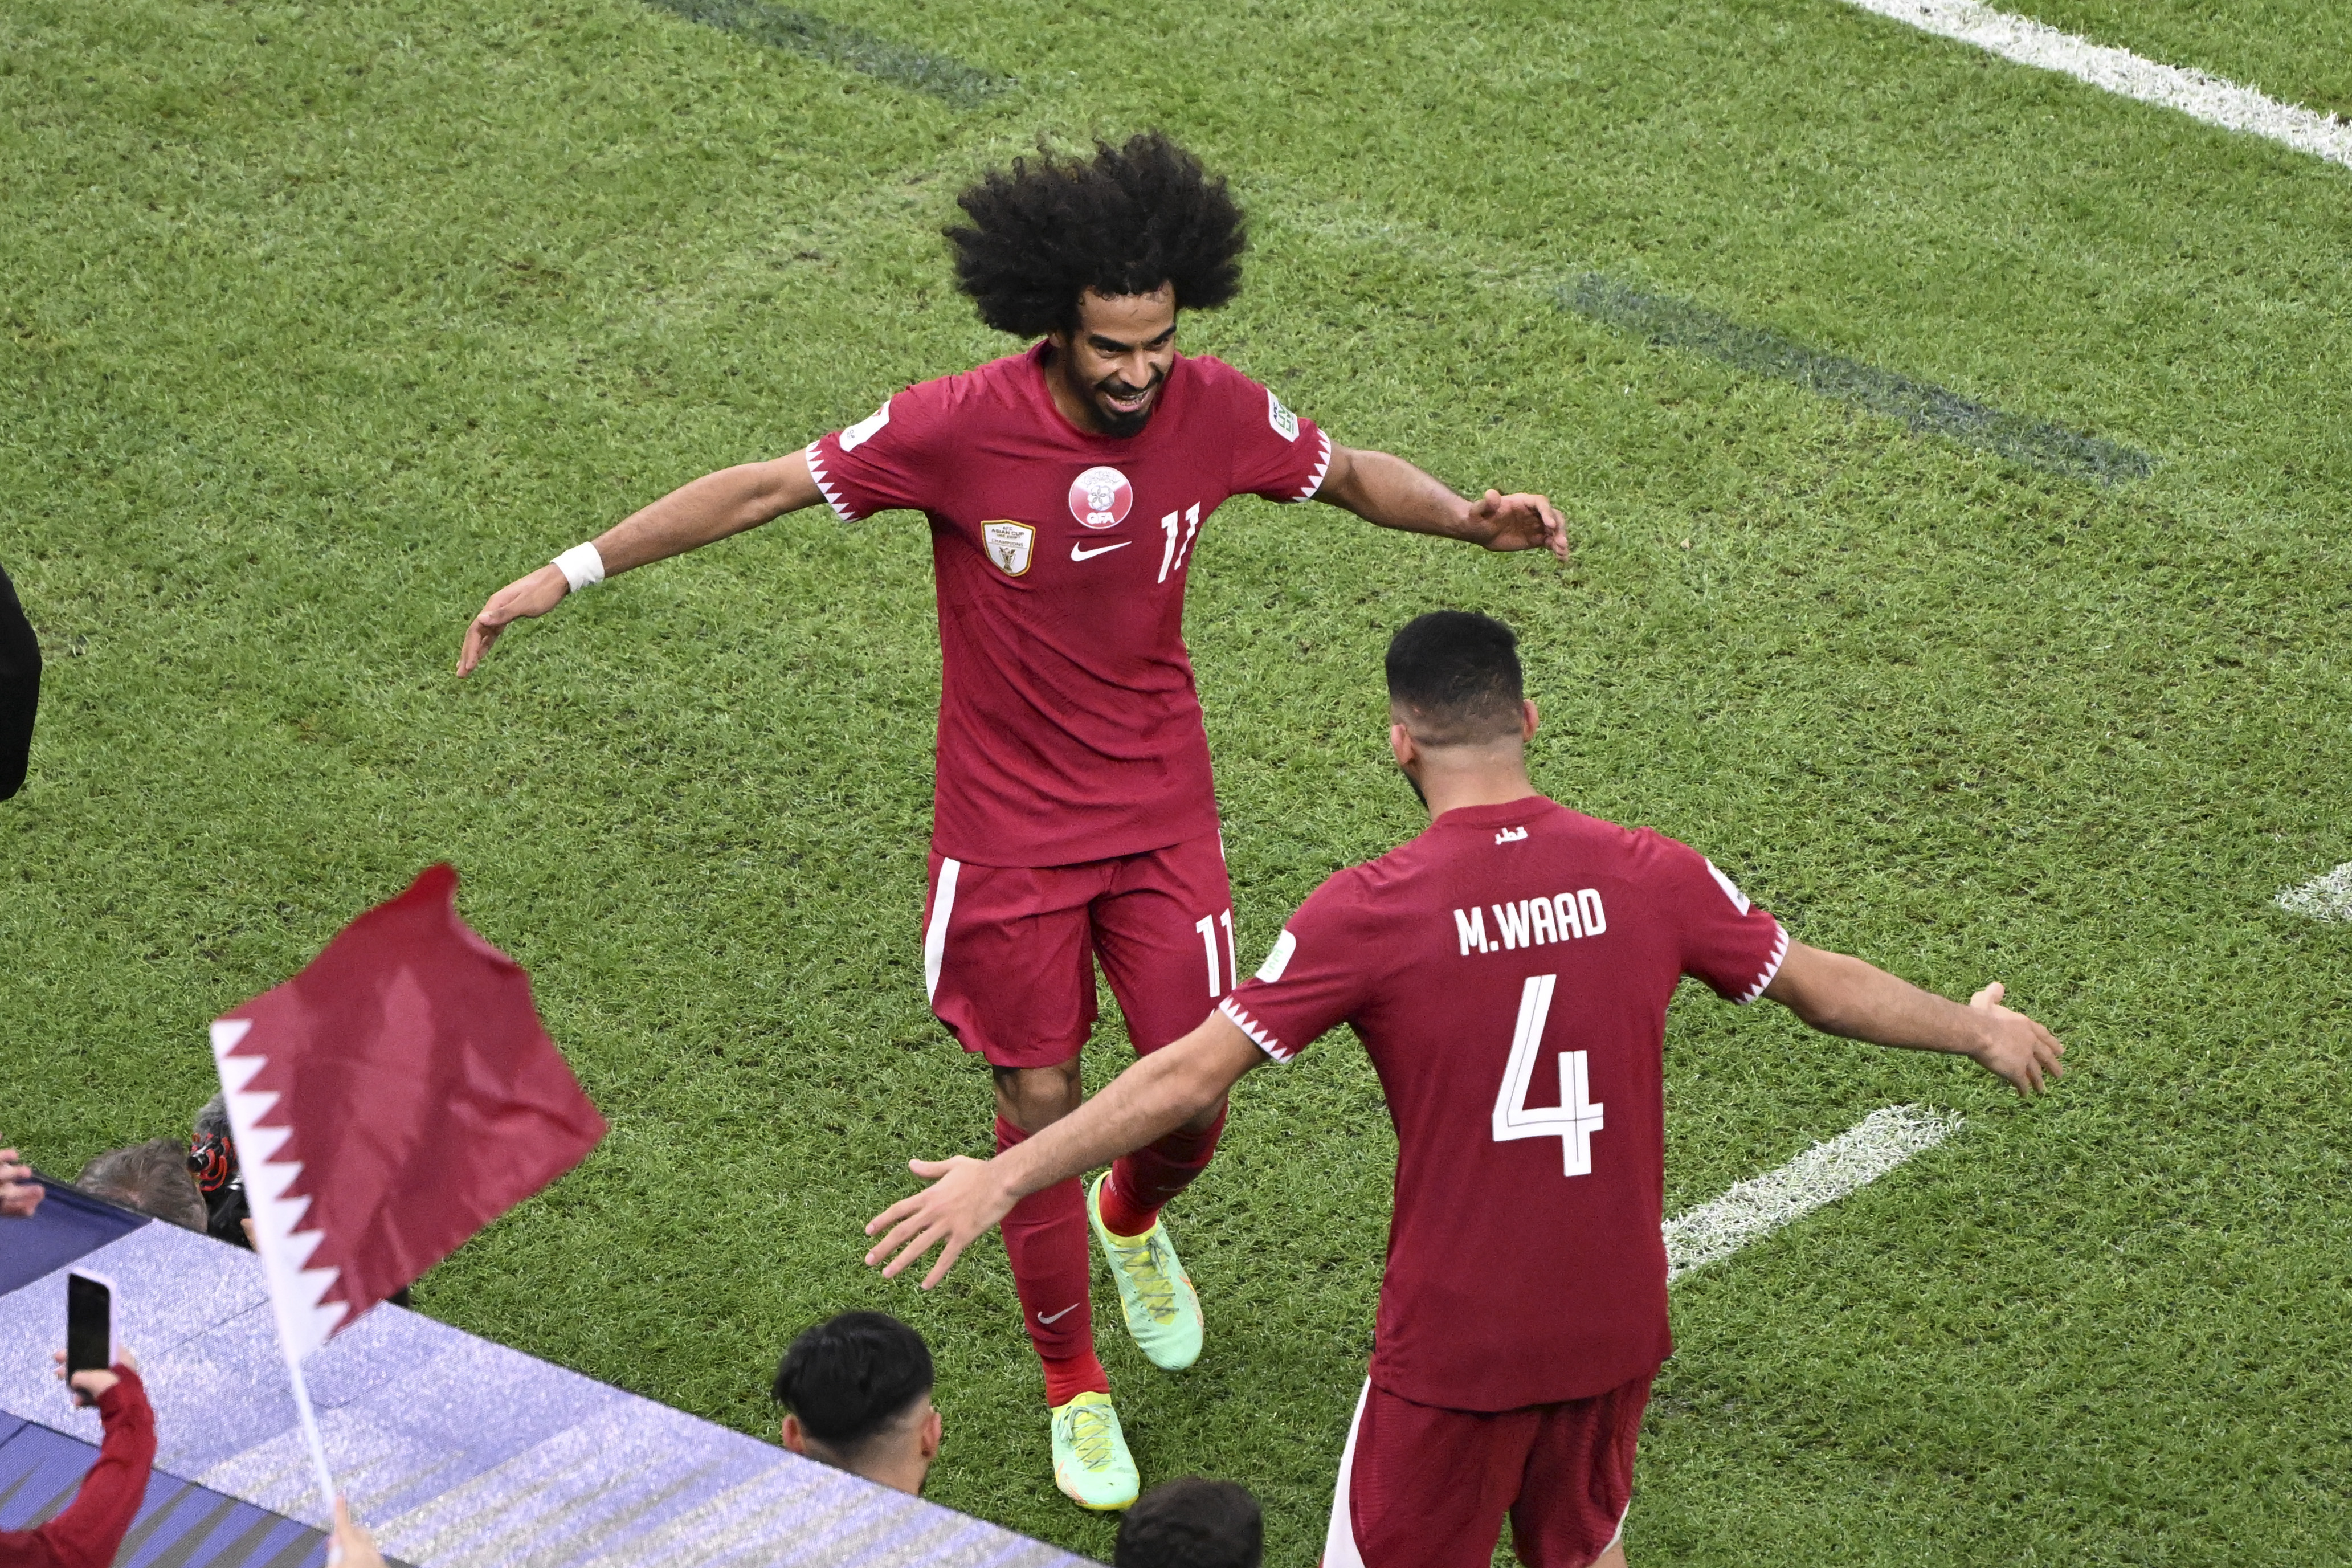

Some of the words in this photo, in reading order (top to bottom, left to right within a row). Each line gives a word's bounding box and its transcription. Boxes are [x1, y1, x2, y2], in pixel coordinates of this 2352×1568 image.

[1086, 512, 1115, 524] QFA
[1157, 501, 1200, 584] 11
[1494, 826, 1528, 846] قطر
[1195, 908, 1236, 998] 11
[1453, 888, 1607, 956] M.WAAD
[1492, 973, 1604, 1177] 4
